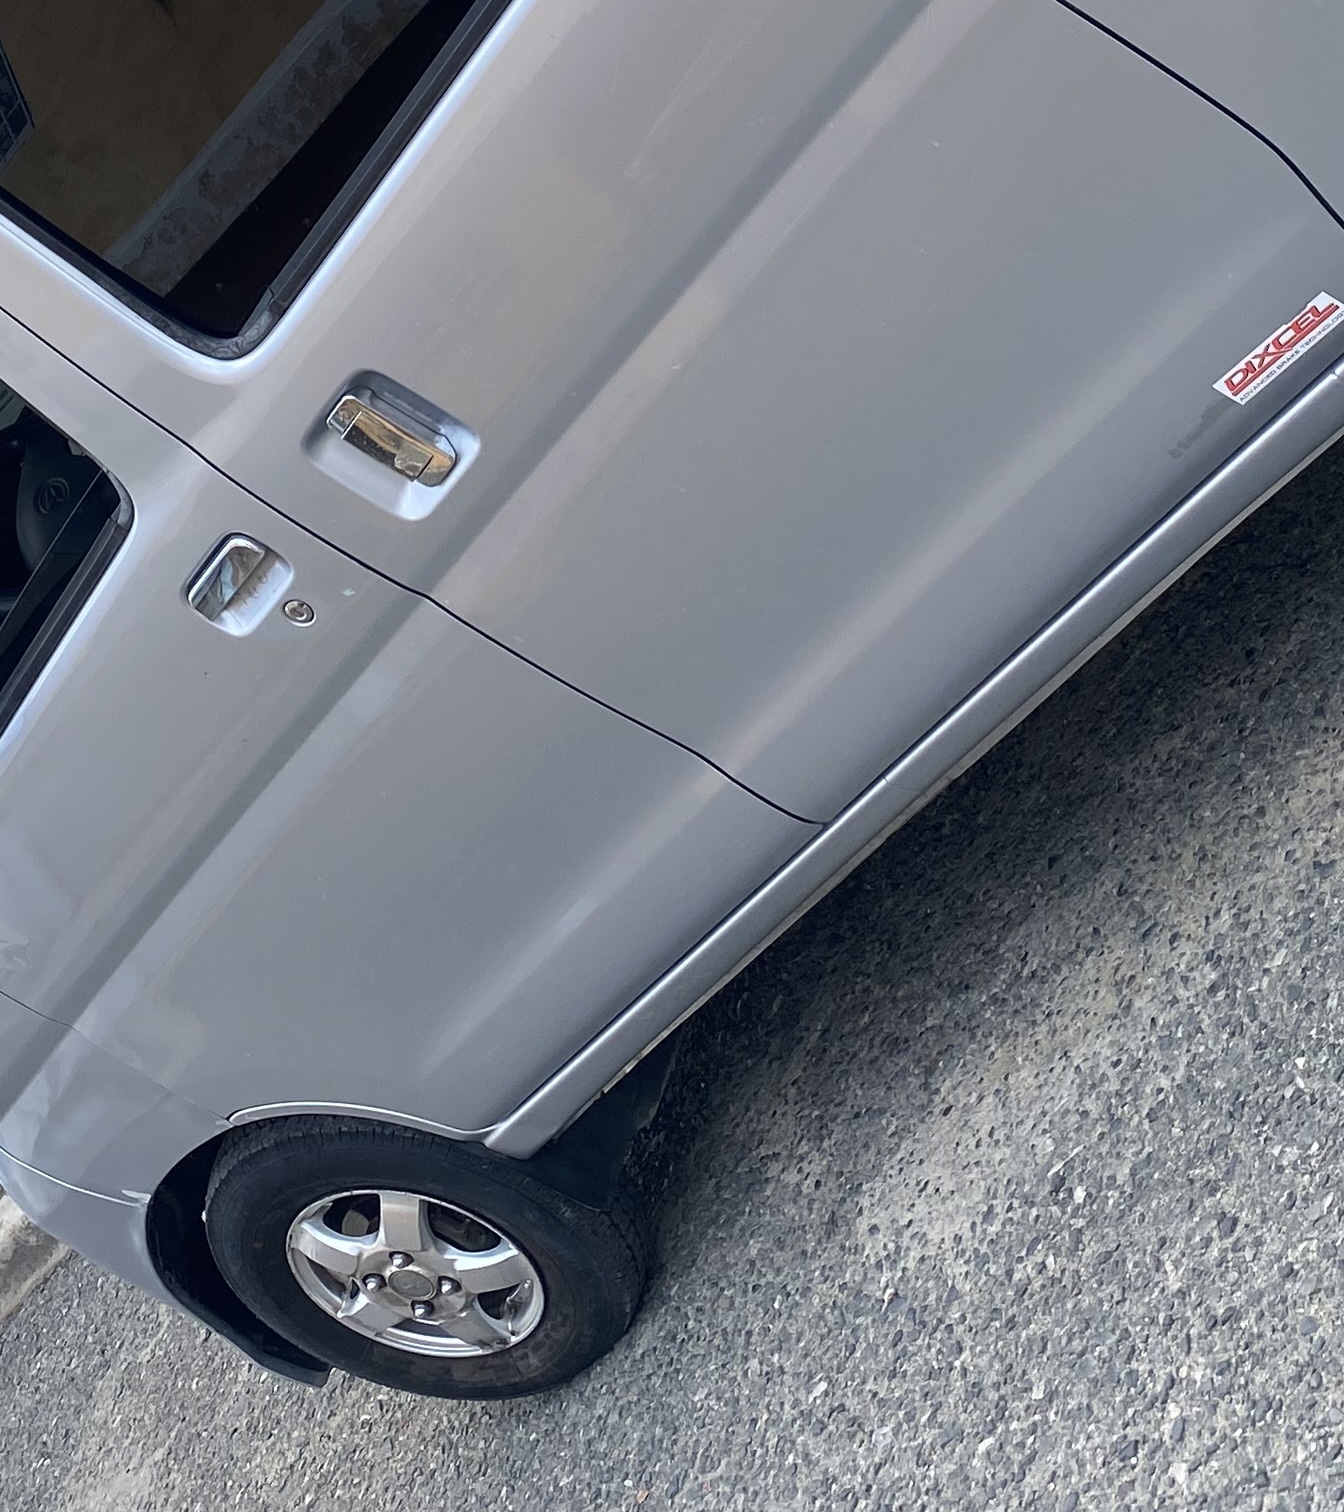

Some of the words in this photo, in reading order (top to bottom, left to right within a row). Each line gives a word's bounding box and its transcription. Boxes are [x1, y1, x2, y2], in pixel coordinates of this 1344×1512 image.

[1224, 303, 1336, 393] DIXCEL
[1239, 370, 1276, 402] ADVANCED
[1277, 350, 1301, 370] BRAKE
